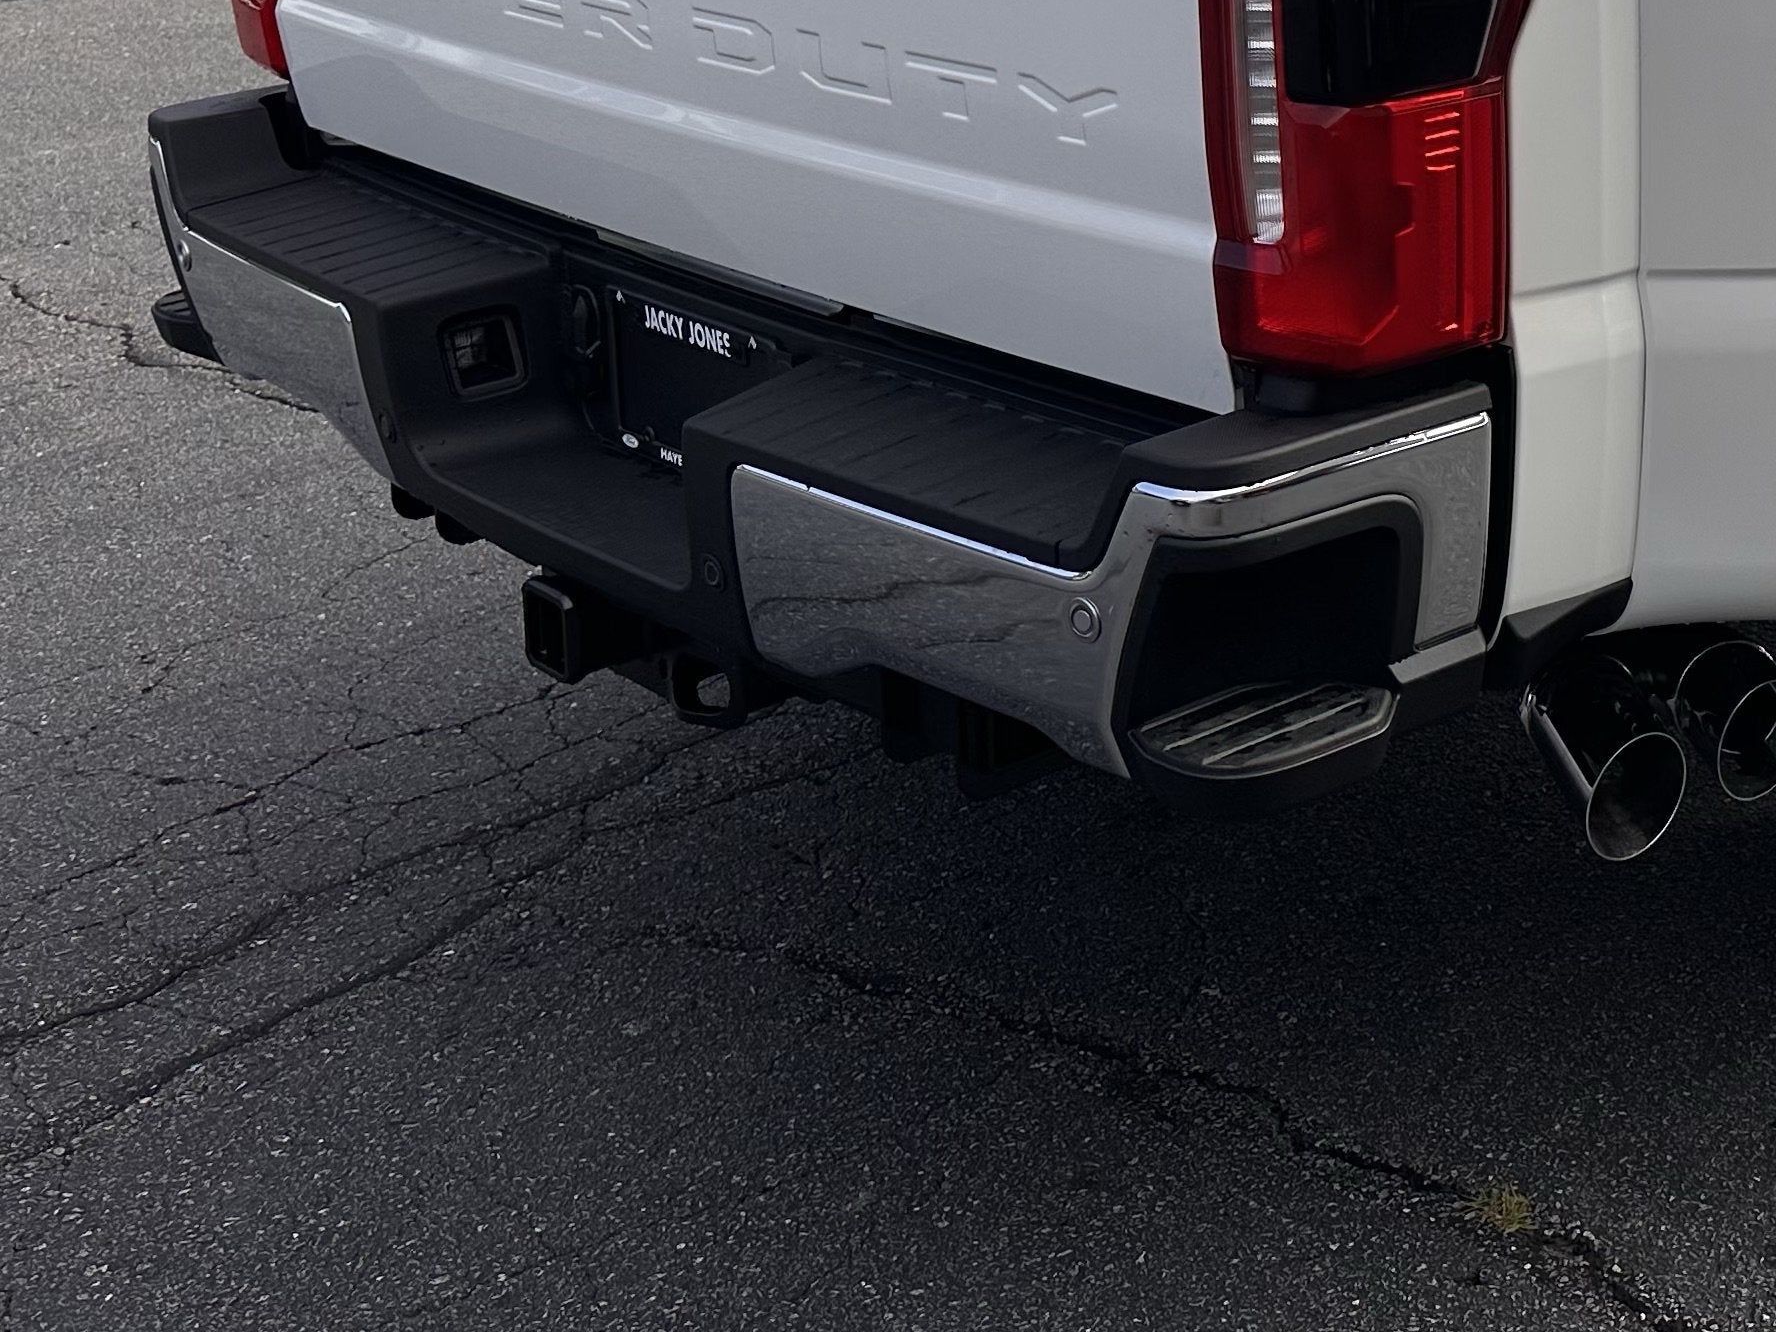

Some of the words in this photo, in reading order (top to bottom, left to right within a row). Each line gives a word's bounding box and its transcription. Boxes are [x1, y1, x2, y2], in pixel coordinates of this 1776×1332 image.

[692, 6, 1117, 146] DUTY
[644, 304, 684, 340] JACKY
[688, 320, 732, 358] JONES
[660, 447, 683, 467] HAYE
